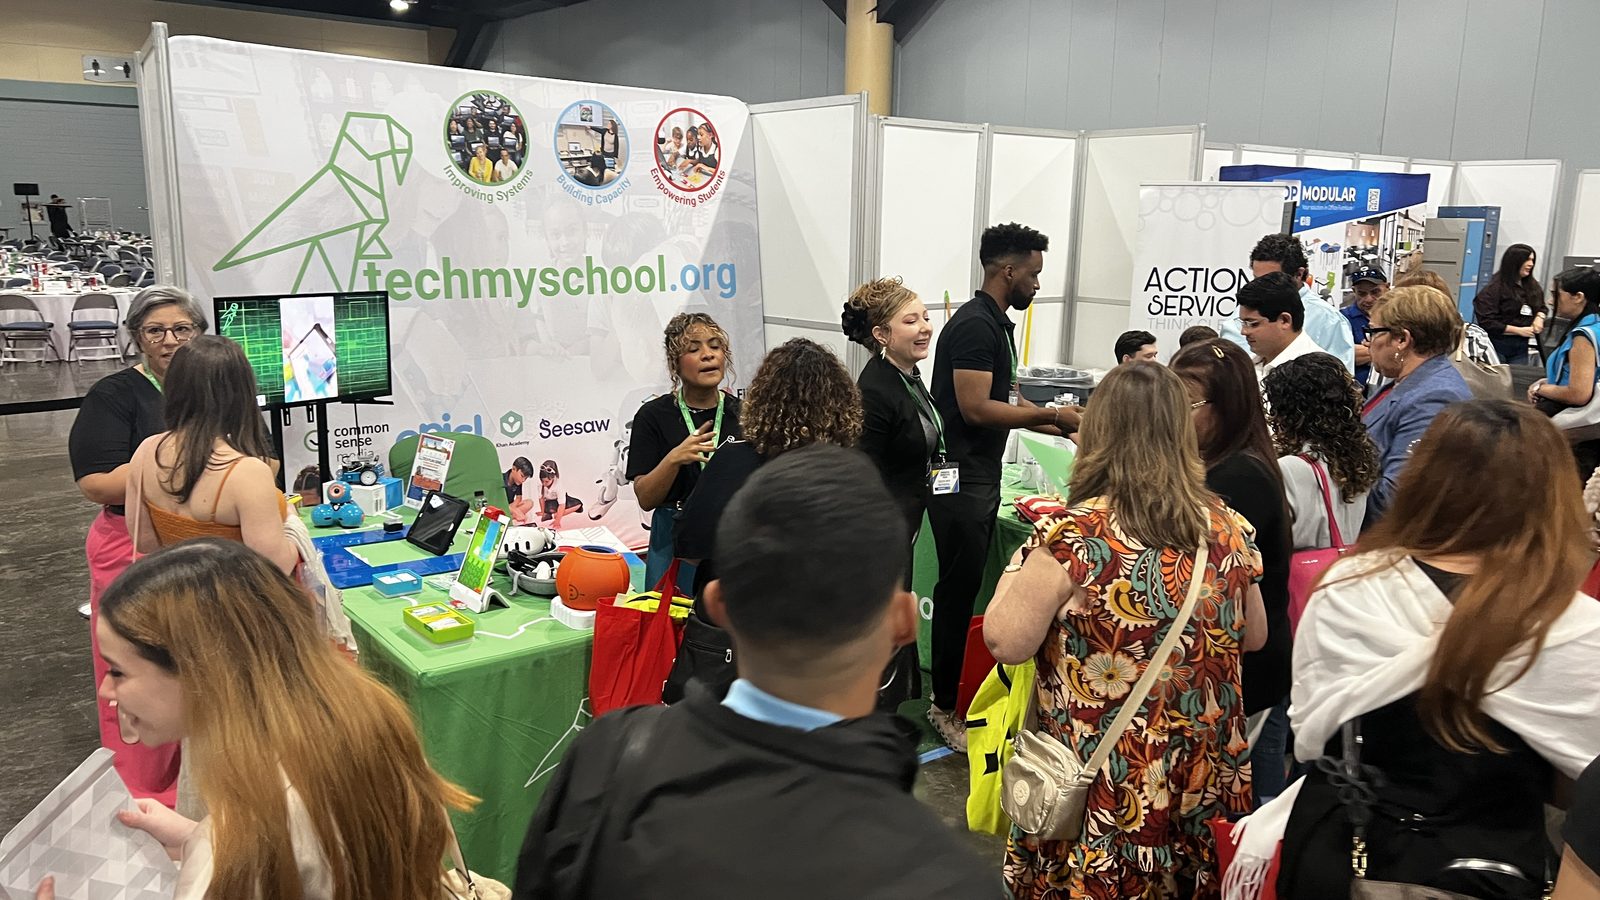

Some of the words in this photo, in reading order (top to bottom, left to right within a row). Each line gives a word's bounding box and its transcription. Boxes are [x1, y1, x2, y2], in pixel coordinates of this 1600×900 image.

[443, 165, 494, 204] Improving
[496, 169, 534, 202] Systems
[556, 175, 593, 206] Building
[595, 177, 632, 204] Capacity
[650, 167, 697, 208] Empowering
[698, 170, 726, 204] Students
[1301, 185, 1356, 202] MODULAR
[363, 254, 737, 308] techmyschool.org
[1147, 295, 1236, 317] SERVIC
[1147, 318, 1191, 330] THINK
[334, 423, 390, 437] common
[539, 418, 610, 439] Seesaw
[335, 436, 372, 449] sense
